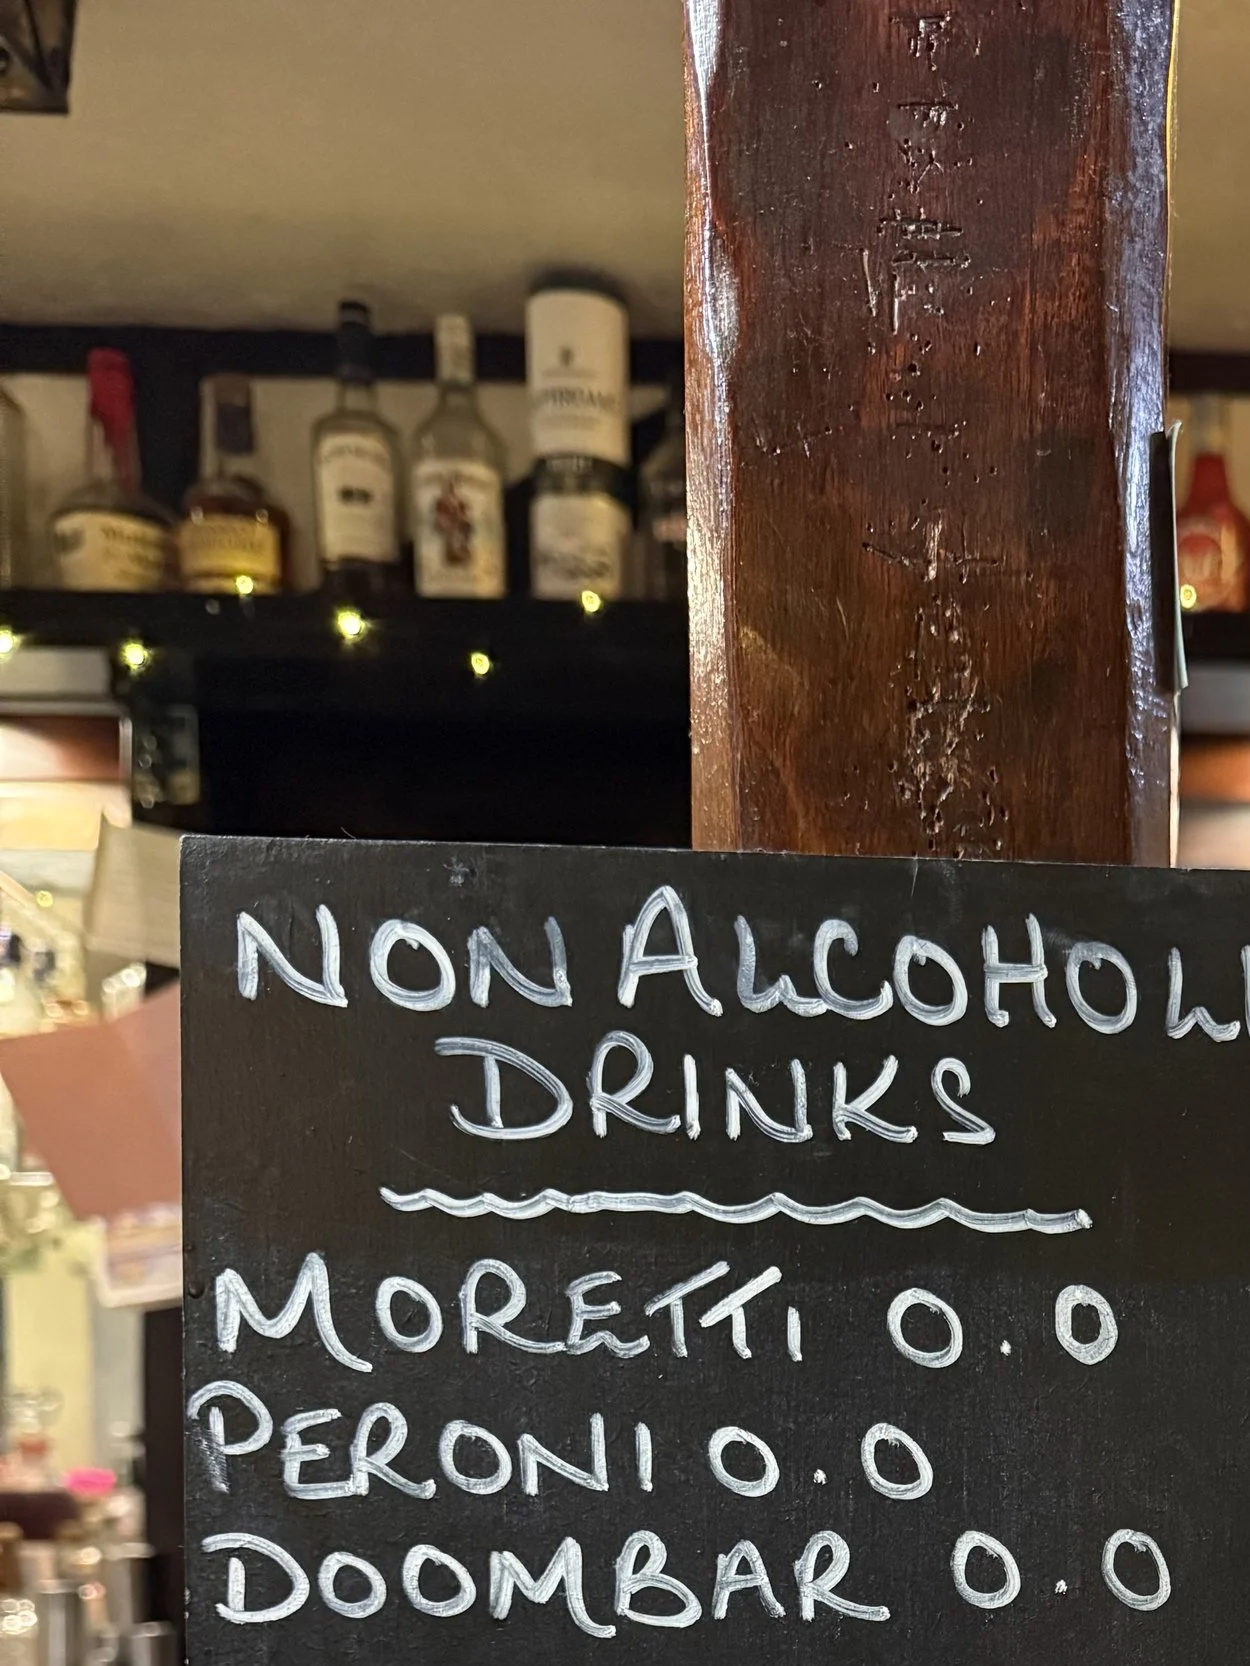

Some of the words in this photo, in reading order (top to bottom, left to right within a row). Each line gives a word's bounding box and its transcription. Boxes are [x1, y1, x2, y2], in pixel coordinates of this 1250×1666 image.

[237, 902, 574, 1010] NON
[434, 1030, 996, 1146] DRINKS
[214, 1250, 803, 1373] MORETTI
[188, 1379, 654, 1500] PERONI
[201, 1529, 891, 1639] DOOMBAR
